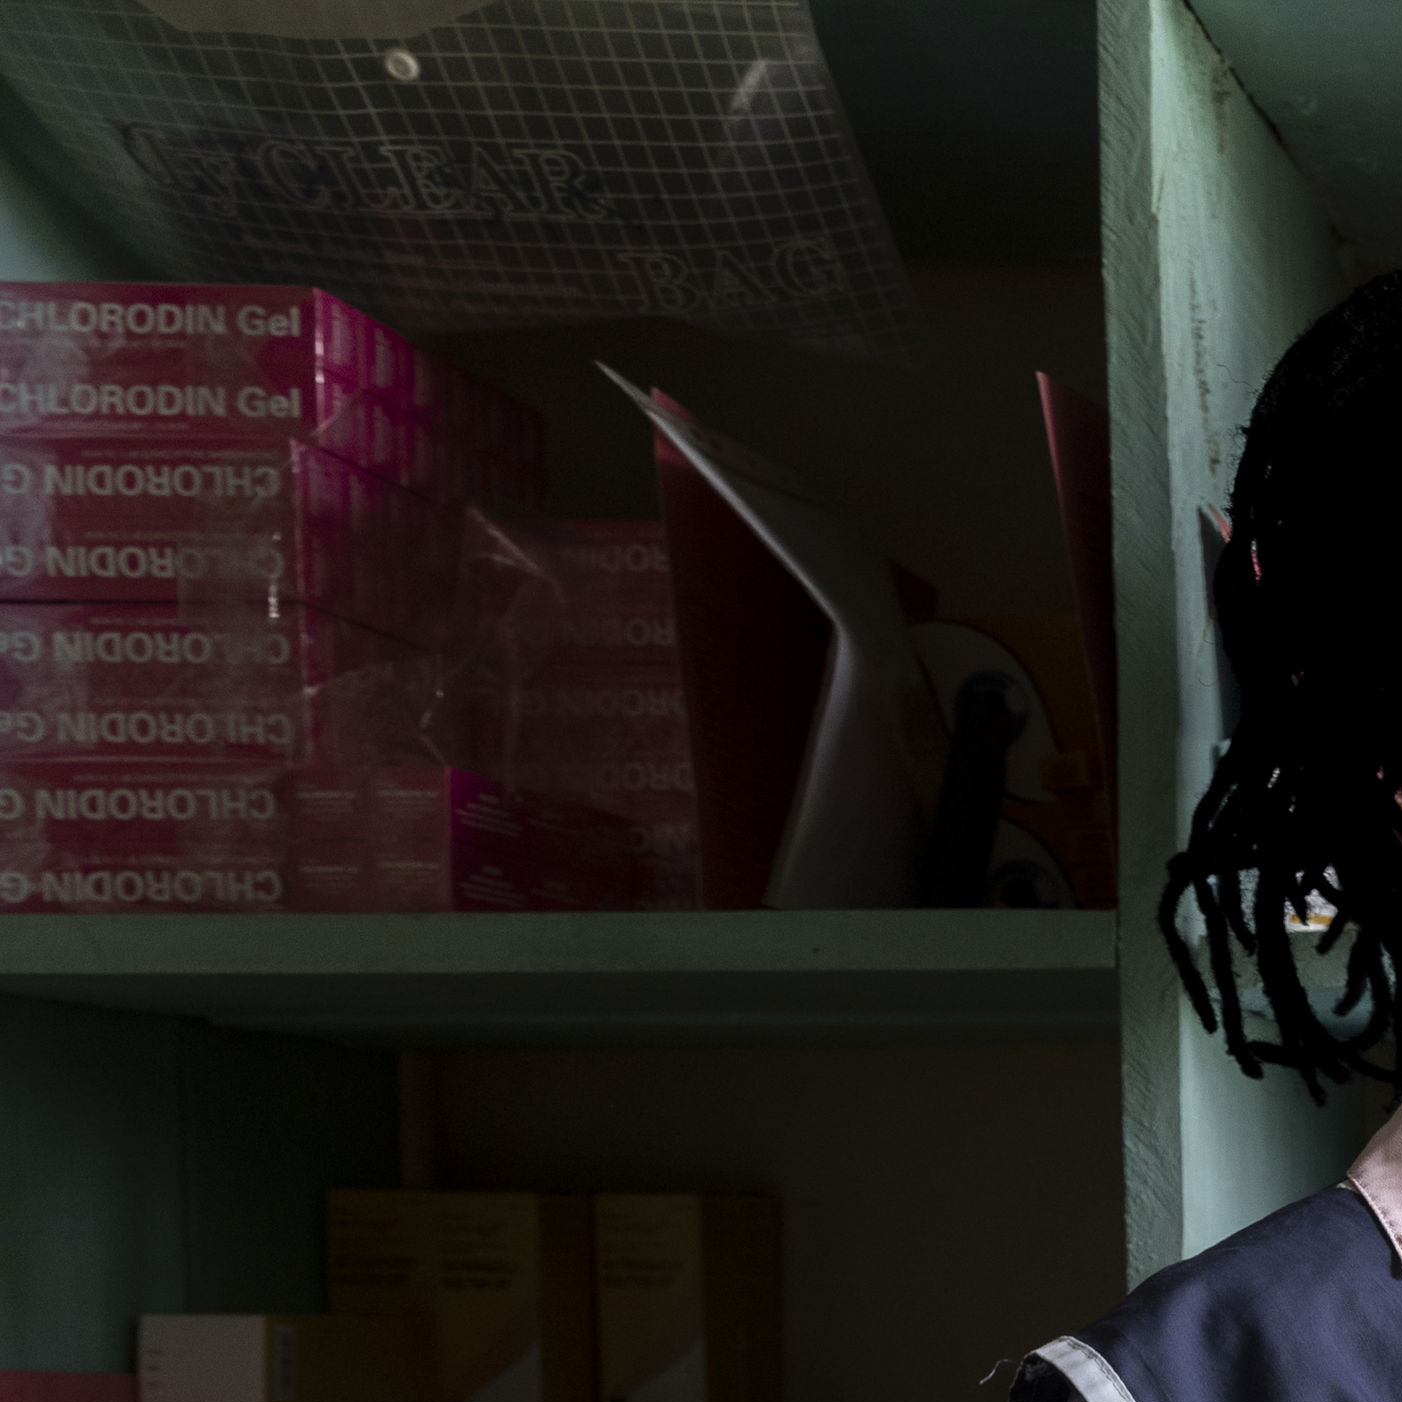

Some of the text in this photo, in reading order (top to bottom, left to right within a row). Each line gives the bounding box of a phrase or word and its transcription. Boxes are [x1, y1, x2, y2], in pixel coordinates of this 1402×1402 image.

[618, 238, 848, 314] BAG
[0, 301, 300, 337] CHLORODIN Gel
[0, 383, 300, 418] CHLORODIN Gel
[43, 463, 282, 498] CHLORODIN
[35, 787, 276, 821] CHLORODIN
[42, 870, 283, 903] CHLORODIN
